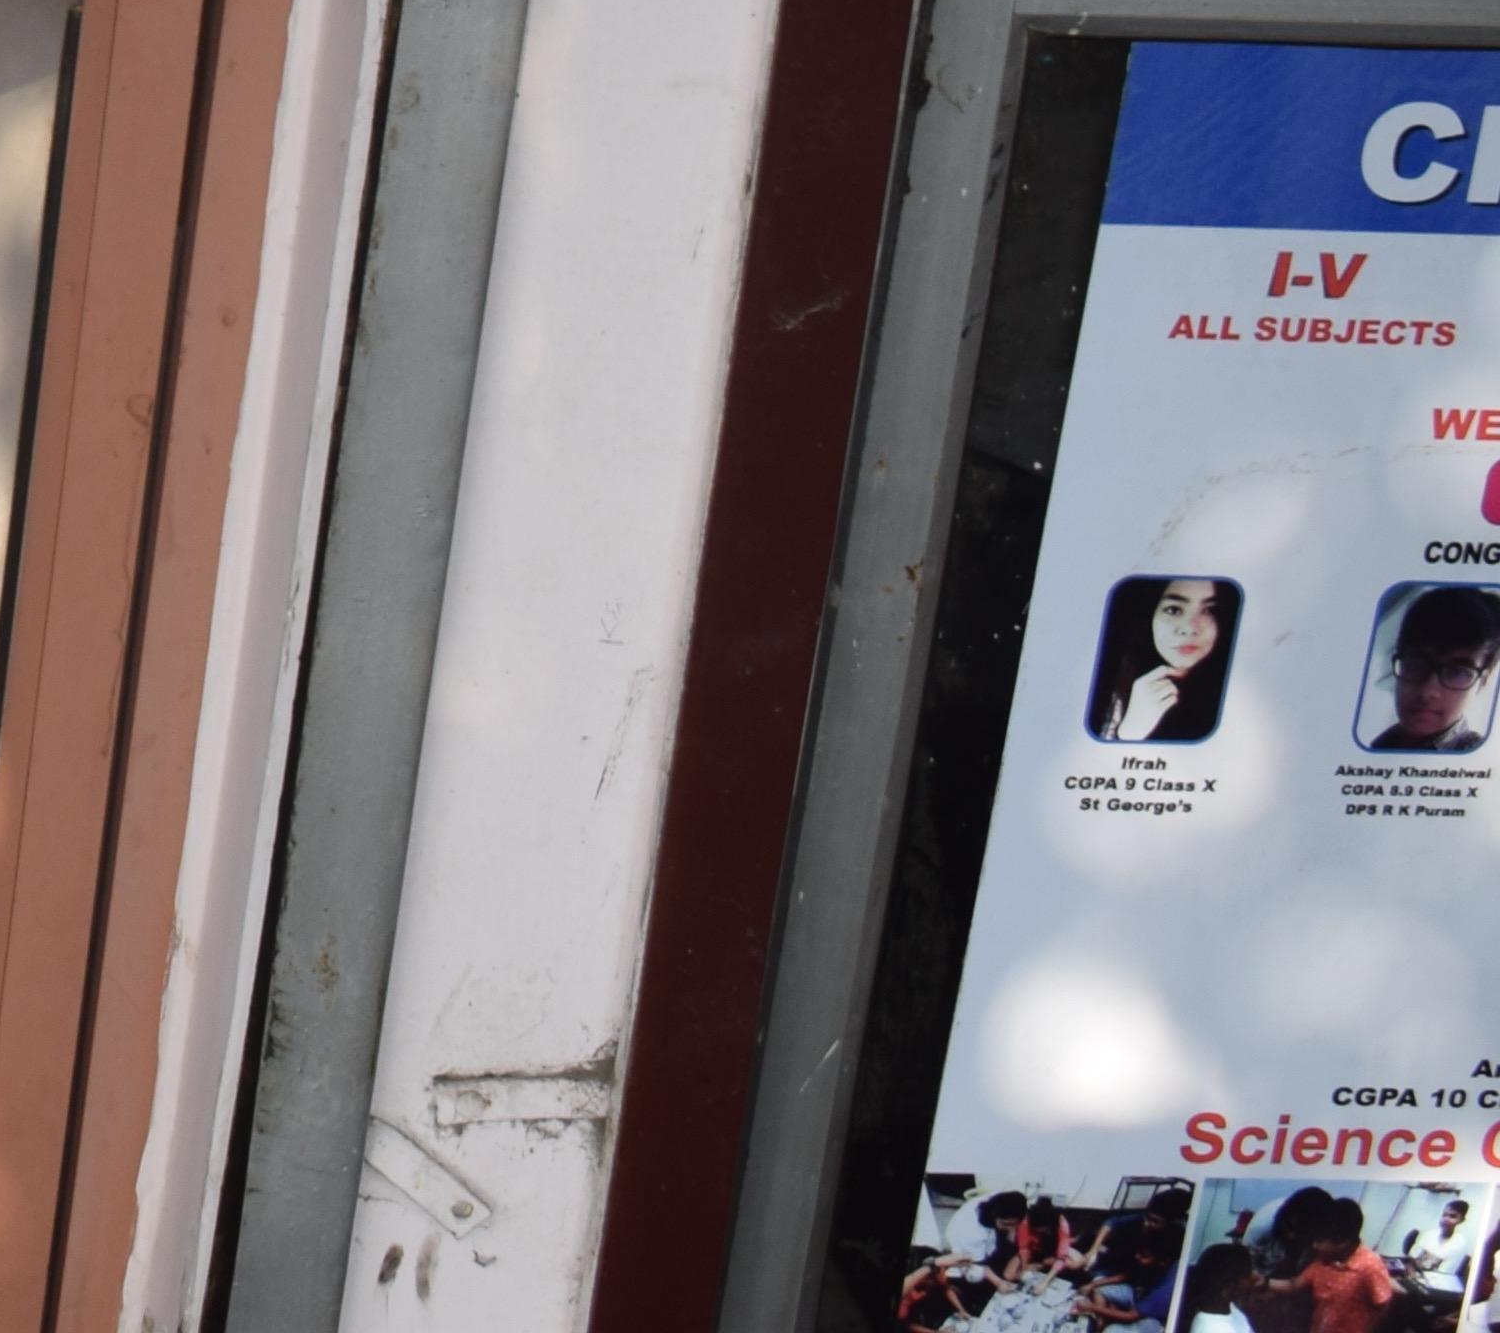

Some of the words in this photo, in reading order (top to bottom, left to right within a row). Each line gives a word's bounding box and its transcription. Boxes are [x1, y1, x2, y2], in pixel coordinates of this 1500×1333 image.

[1267, 251, 1367, 299] I-V
[1168, 314, 1240, 341] ALL
[1253, 316, 1457, 346] SUBJECTS
[1121, 756, 1167, 771] Ifrah
[1334, 765, 1394, 780] Akshay
[1064, 776, 1118, 790] CGPA
[1124, 777, 1136, 791] 9
[1143, 778, 1196, 792] Class
[1202, 779, 1217, 793] X
[1341, 784, 1384, 797] CGPA
[1419, 785, 1461, 798] Class
[1466, 786, 1478, 798] X
[1079, 797, 1100, 811] St
[1345, 803, 1377, 816] DPS
[1382, 804, 1394, 816] R
[1399, 805, 1410, 816] K
[1415, 805, 1466, 818] Puram
[1332, 1086, 1418, 1108] CGPA
[1430, 1088, 1467, 1109] 10
[1180, 1110, 1456, 1169] Science
